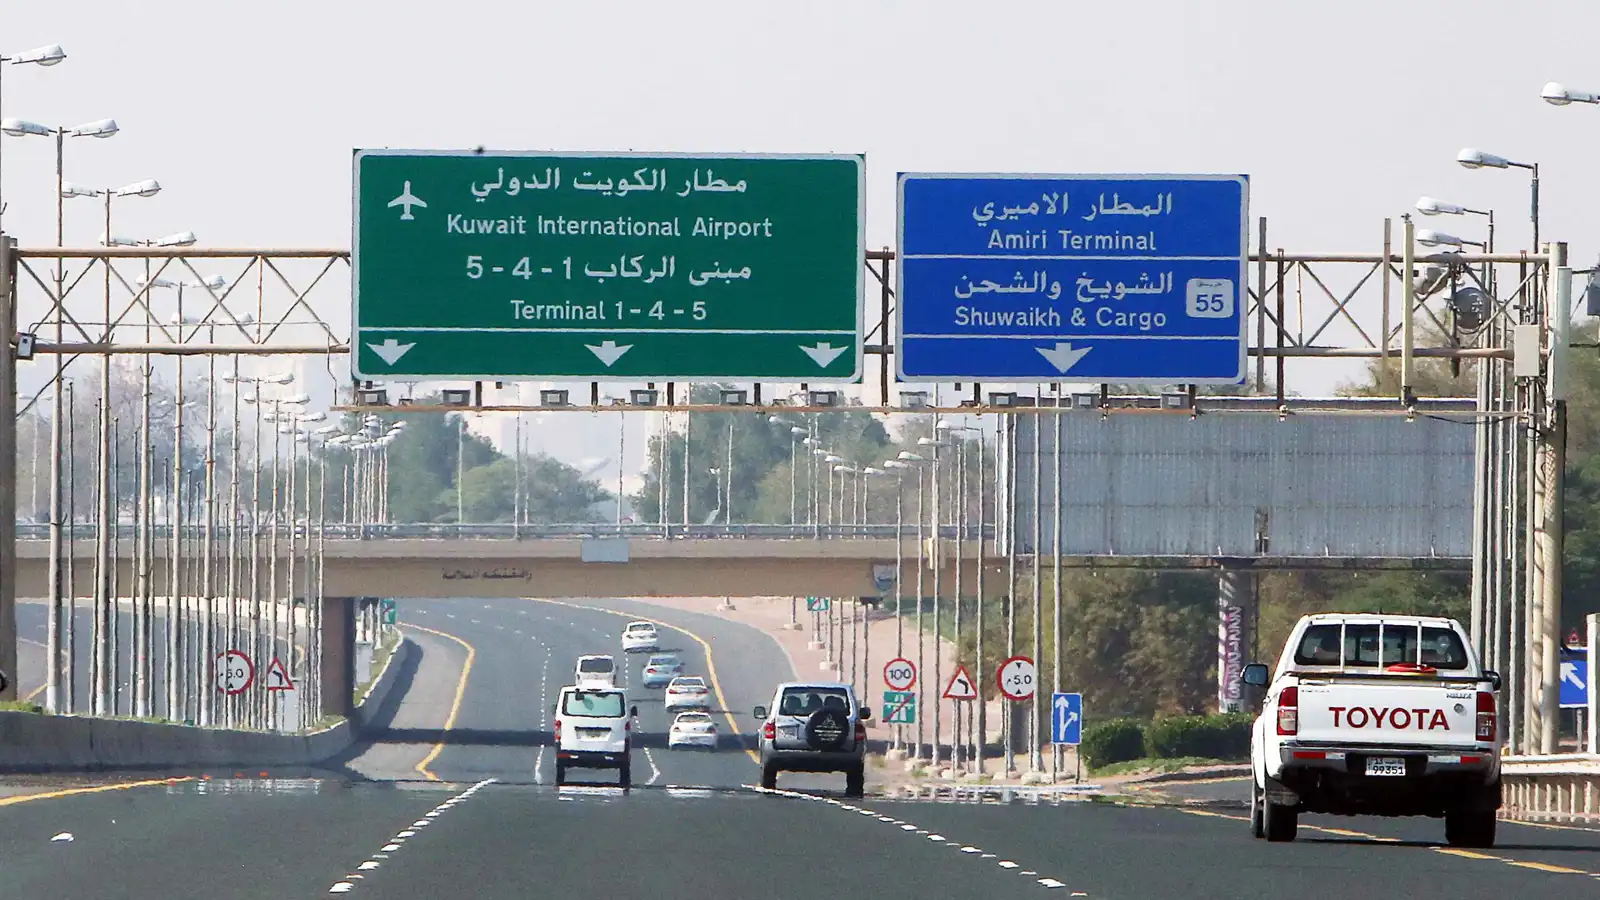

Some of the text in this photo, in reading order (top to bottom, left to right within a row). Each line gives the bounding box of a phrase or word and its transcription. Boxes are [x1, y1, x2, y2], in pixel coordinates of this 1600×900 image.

[471, 167, 747, 203] مطار الكويت الدولي
[972, 192, 1172, 227] المطار الاميري
[447, 213, 772, 240] Kuwait International Airport
[987, 229, 1157, 250] Amiri Terminal
[466, 255, 484, 280] 5
[512, 256, 533, 280] 4
[562, 256, 571, 280] 1
[585, 255, 675, 284] الركاب
[689, 261, 752, 286] مبنى
[954, 270, 1173, 302] الشويخ والشحن
[510, 299, 605, 320] Terminal
[1196, 294, 1224, 312] 55
[954, 306, 1166, 331] Shuwaikh & Cargo
[888, 668, 912, 681] 100
[1013, 674, 1033, 686] 5.0
[1329, 706, 1450, 731] TOYOTA
[1372, 765, 1404, 775] 99351
